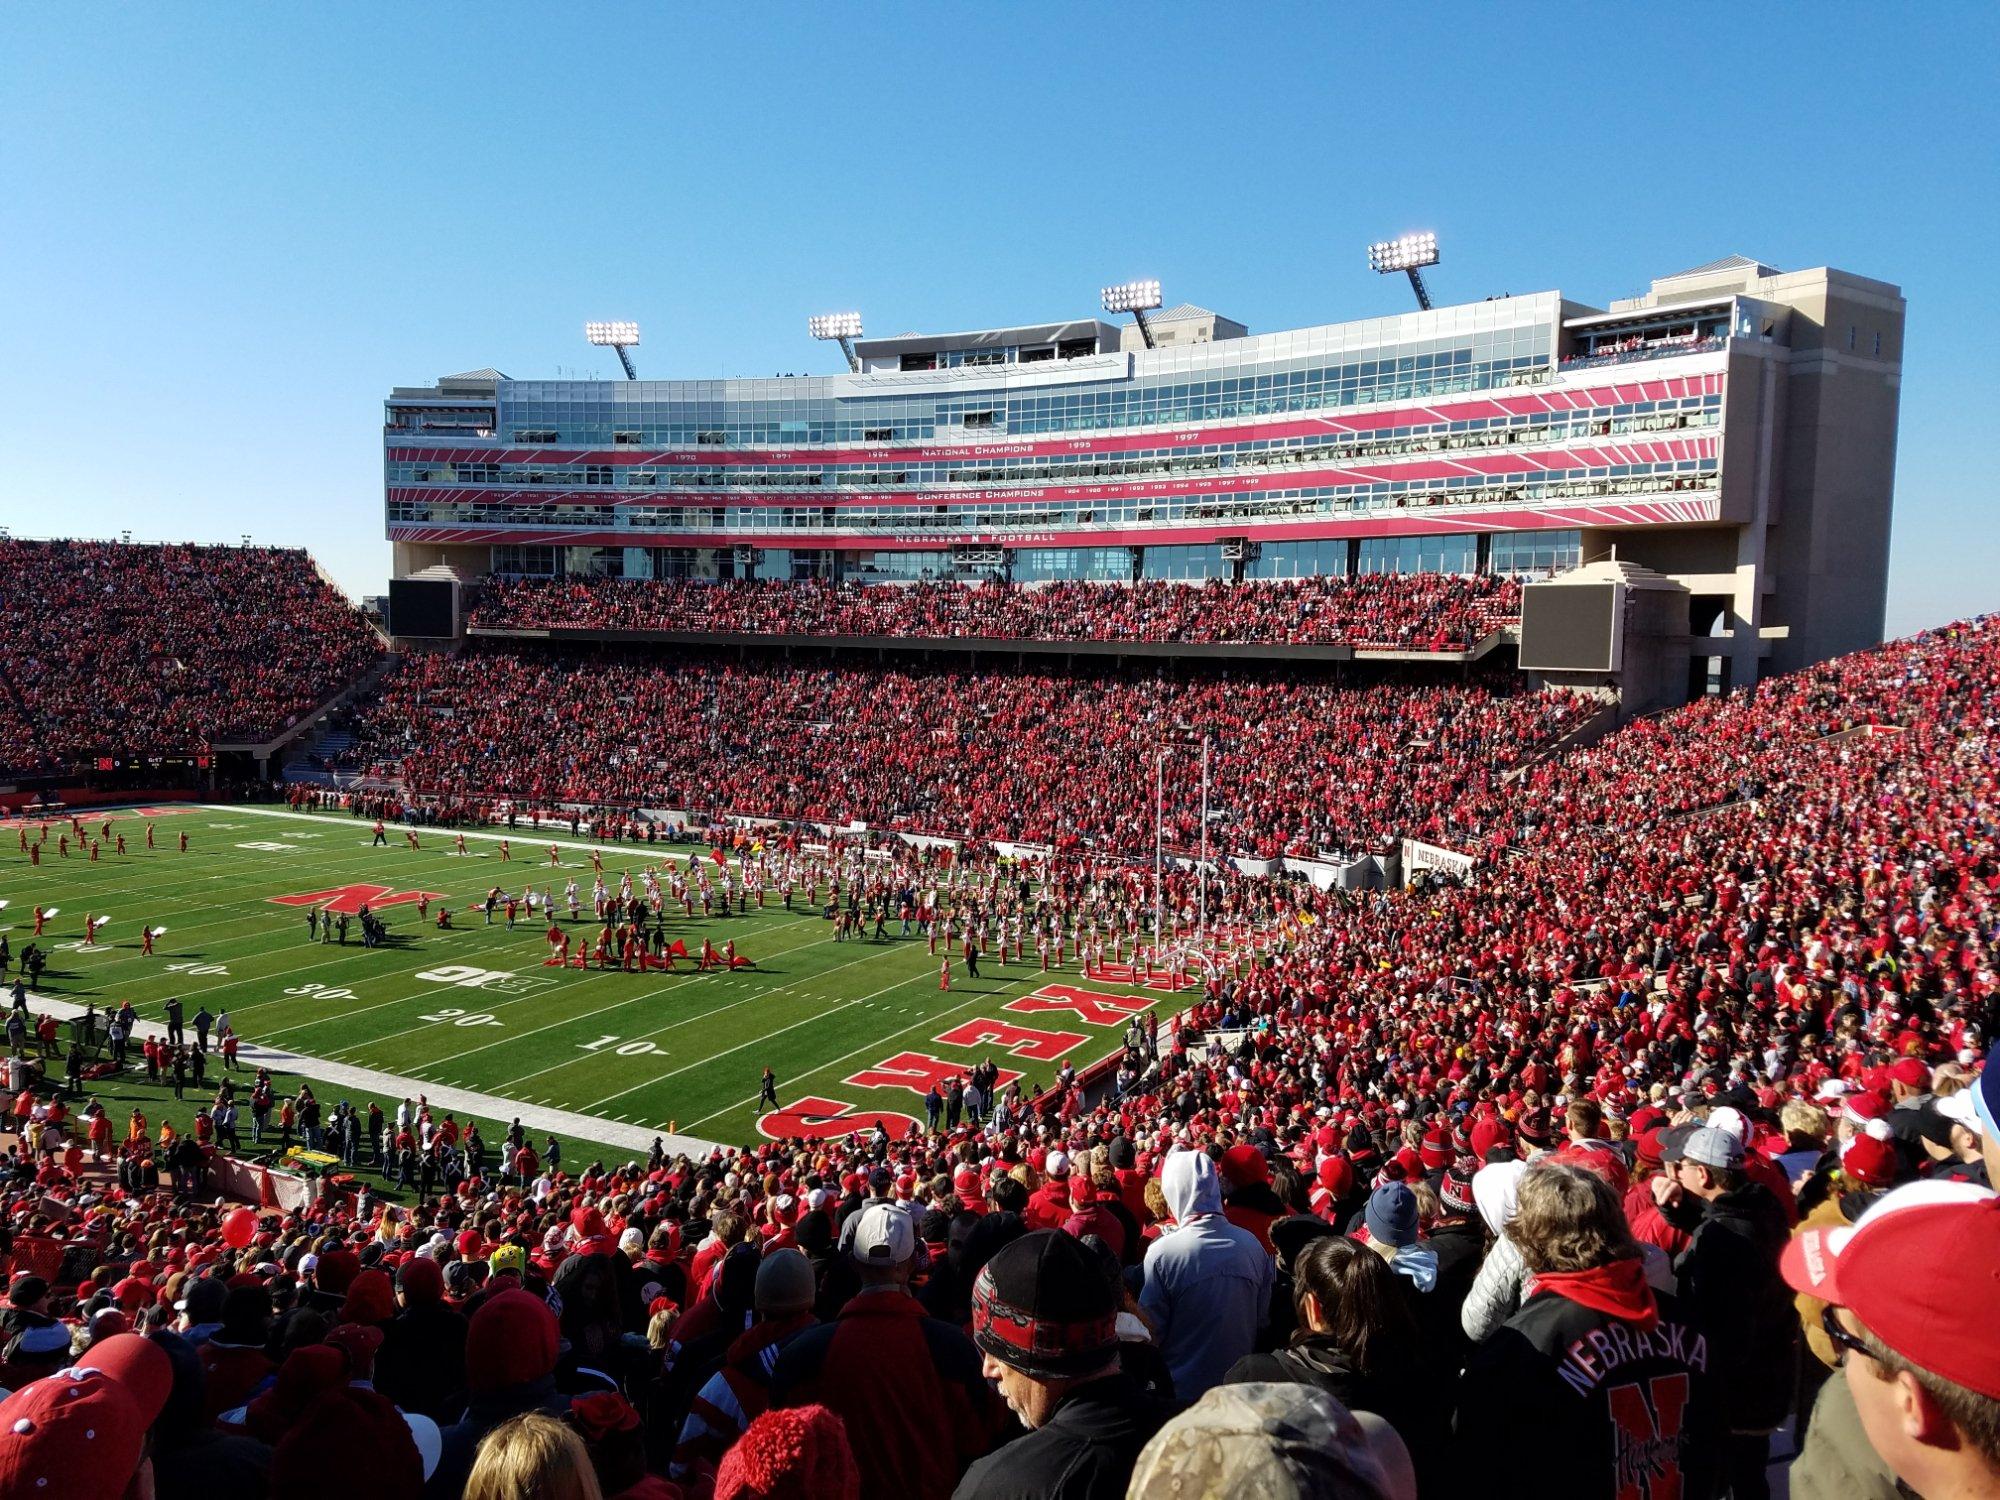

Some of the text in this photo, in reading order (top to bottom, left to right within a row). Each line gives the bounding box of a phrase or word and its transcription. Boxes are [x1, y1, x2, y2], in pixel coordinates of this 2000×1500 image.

[867, 451, 889, 459] 1994
[922, 447, 970, 457] NATIONAL
[975, 444, 1034, 455] CHAMPIONS
[1068, 441, 1091, 449] 1995
[1174, 432, 1199, 442] 1997
[916, 491, 982, 500] CONFERENCE
[985, 489, 1045, 499] CHAMPIONS
[896, 533, 1056, 543] NEBRASKA N FOOTBALL
[98, 757, 113, 770] N
[164, 962, 228, 976] 40
[283, 983, 353, 1000] 30
[417, 1008, 496, 1027] 20
[575, 1035, 657, 1056] 10
[1449, 1184, 1463, 1200] N
[1556, 1320, 1707, 1397] NEBRASKA
